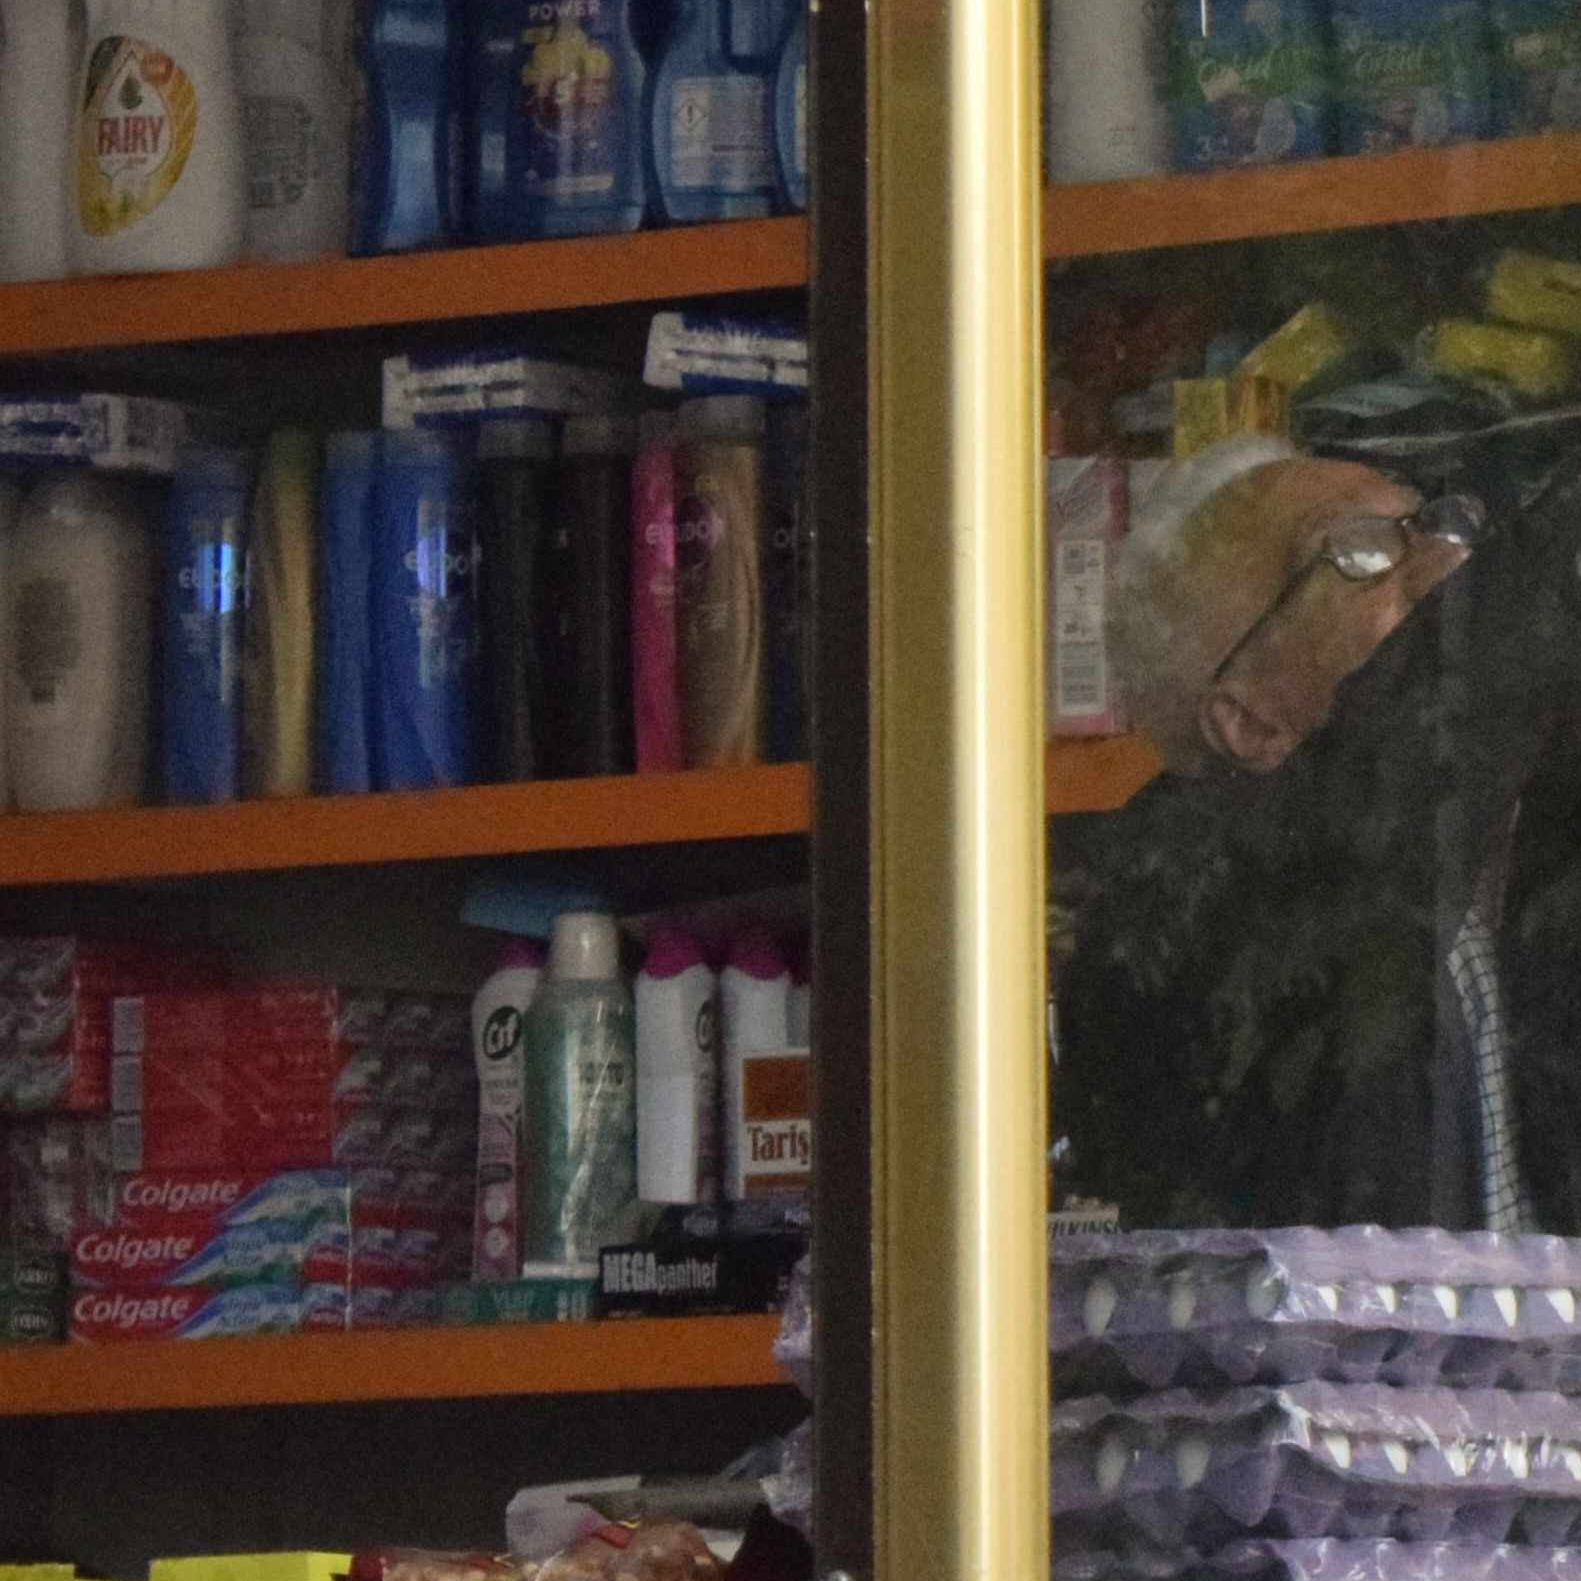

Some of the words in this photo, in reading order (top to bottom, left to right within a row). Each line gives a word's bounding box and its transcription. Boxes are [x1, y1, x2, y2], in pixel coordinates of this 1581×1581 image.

[97, 114, 165, 157] FAIRY
[122, 1177, 243, 1212] Colgate
[76, 1233, 195, 1267] Colgate
[603, 1253, 655, 1295] MEGA
[72, 1293, 190, 1328] Colgate
